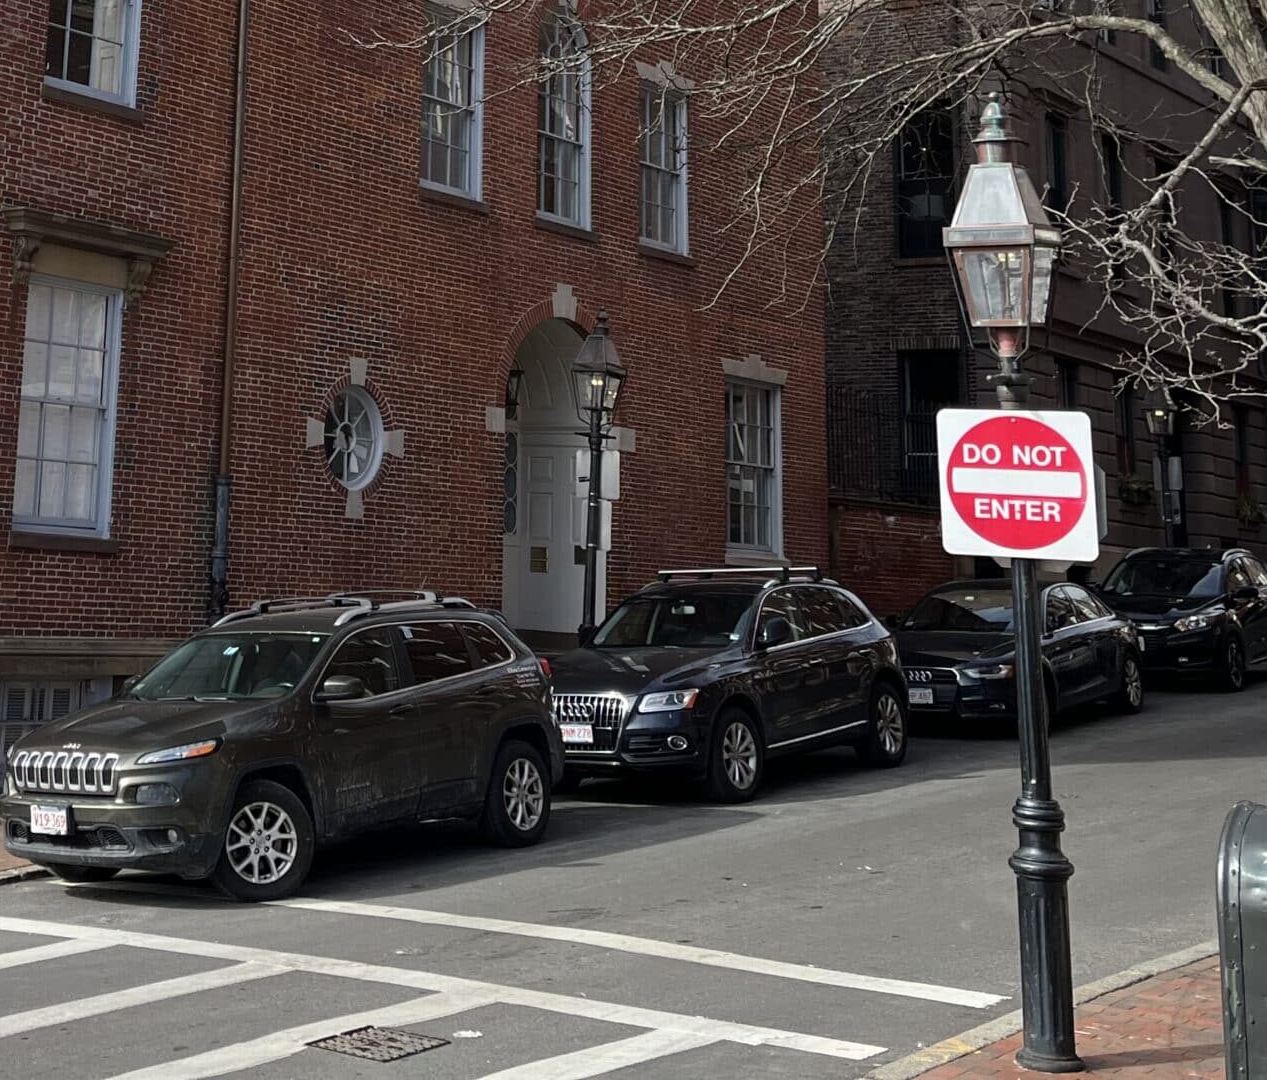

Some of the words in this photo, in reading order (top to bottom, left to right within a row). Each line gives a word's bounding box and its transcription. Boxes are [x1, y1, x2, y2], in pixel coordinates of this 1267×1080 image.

[962, 443, 1001, 465] DO
[1012, 444, 1067, 467] NOT
[974, 498, 1061, 522] ENTER
